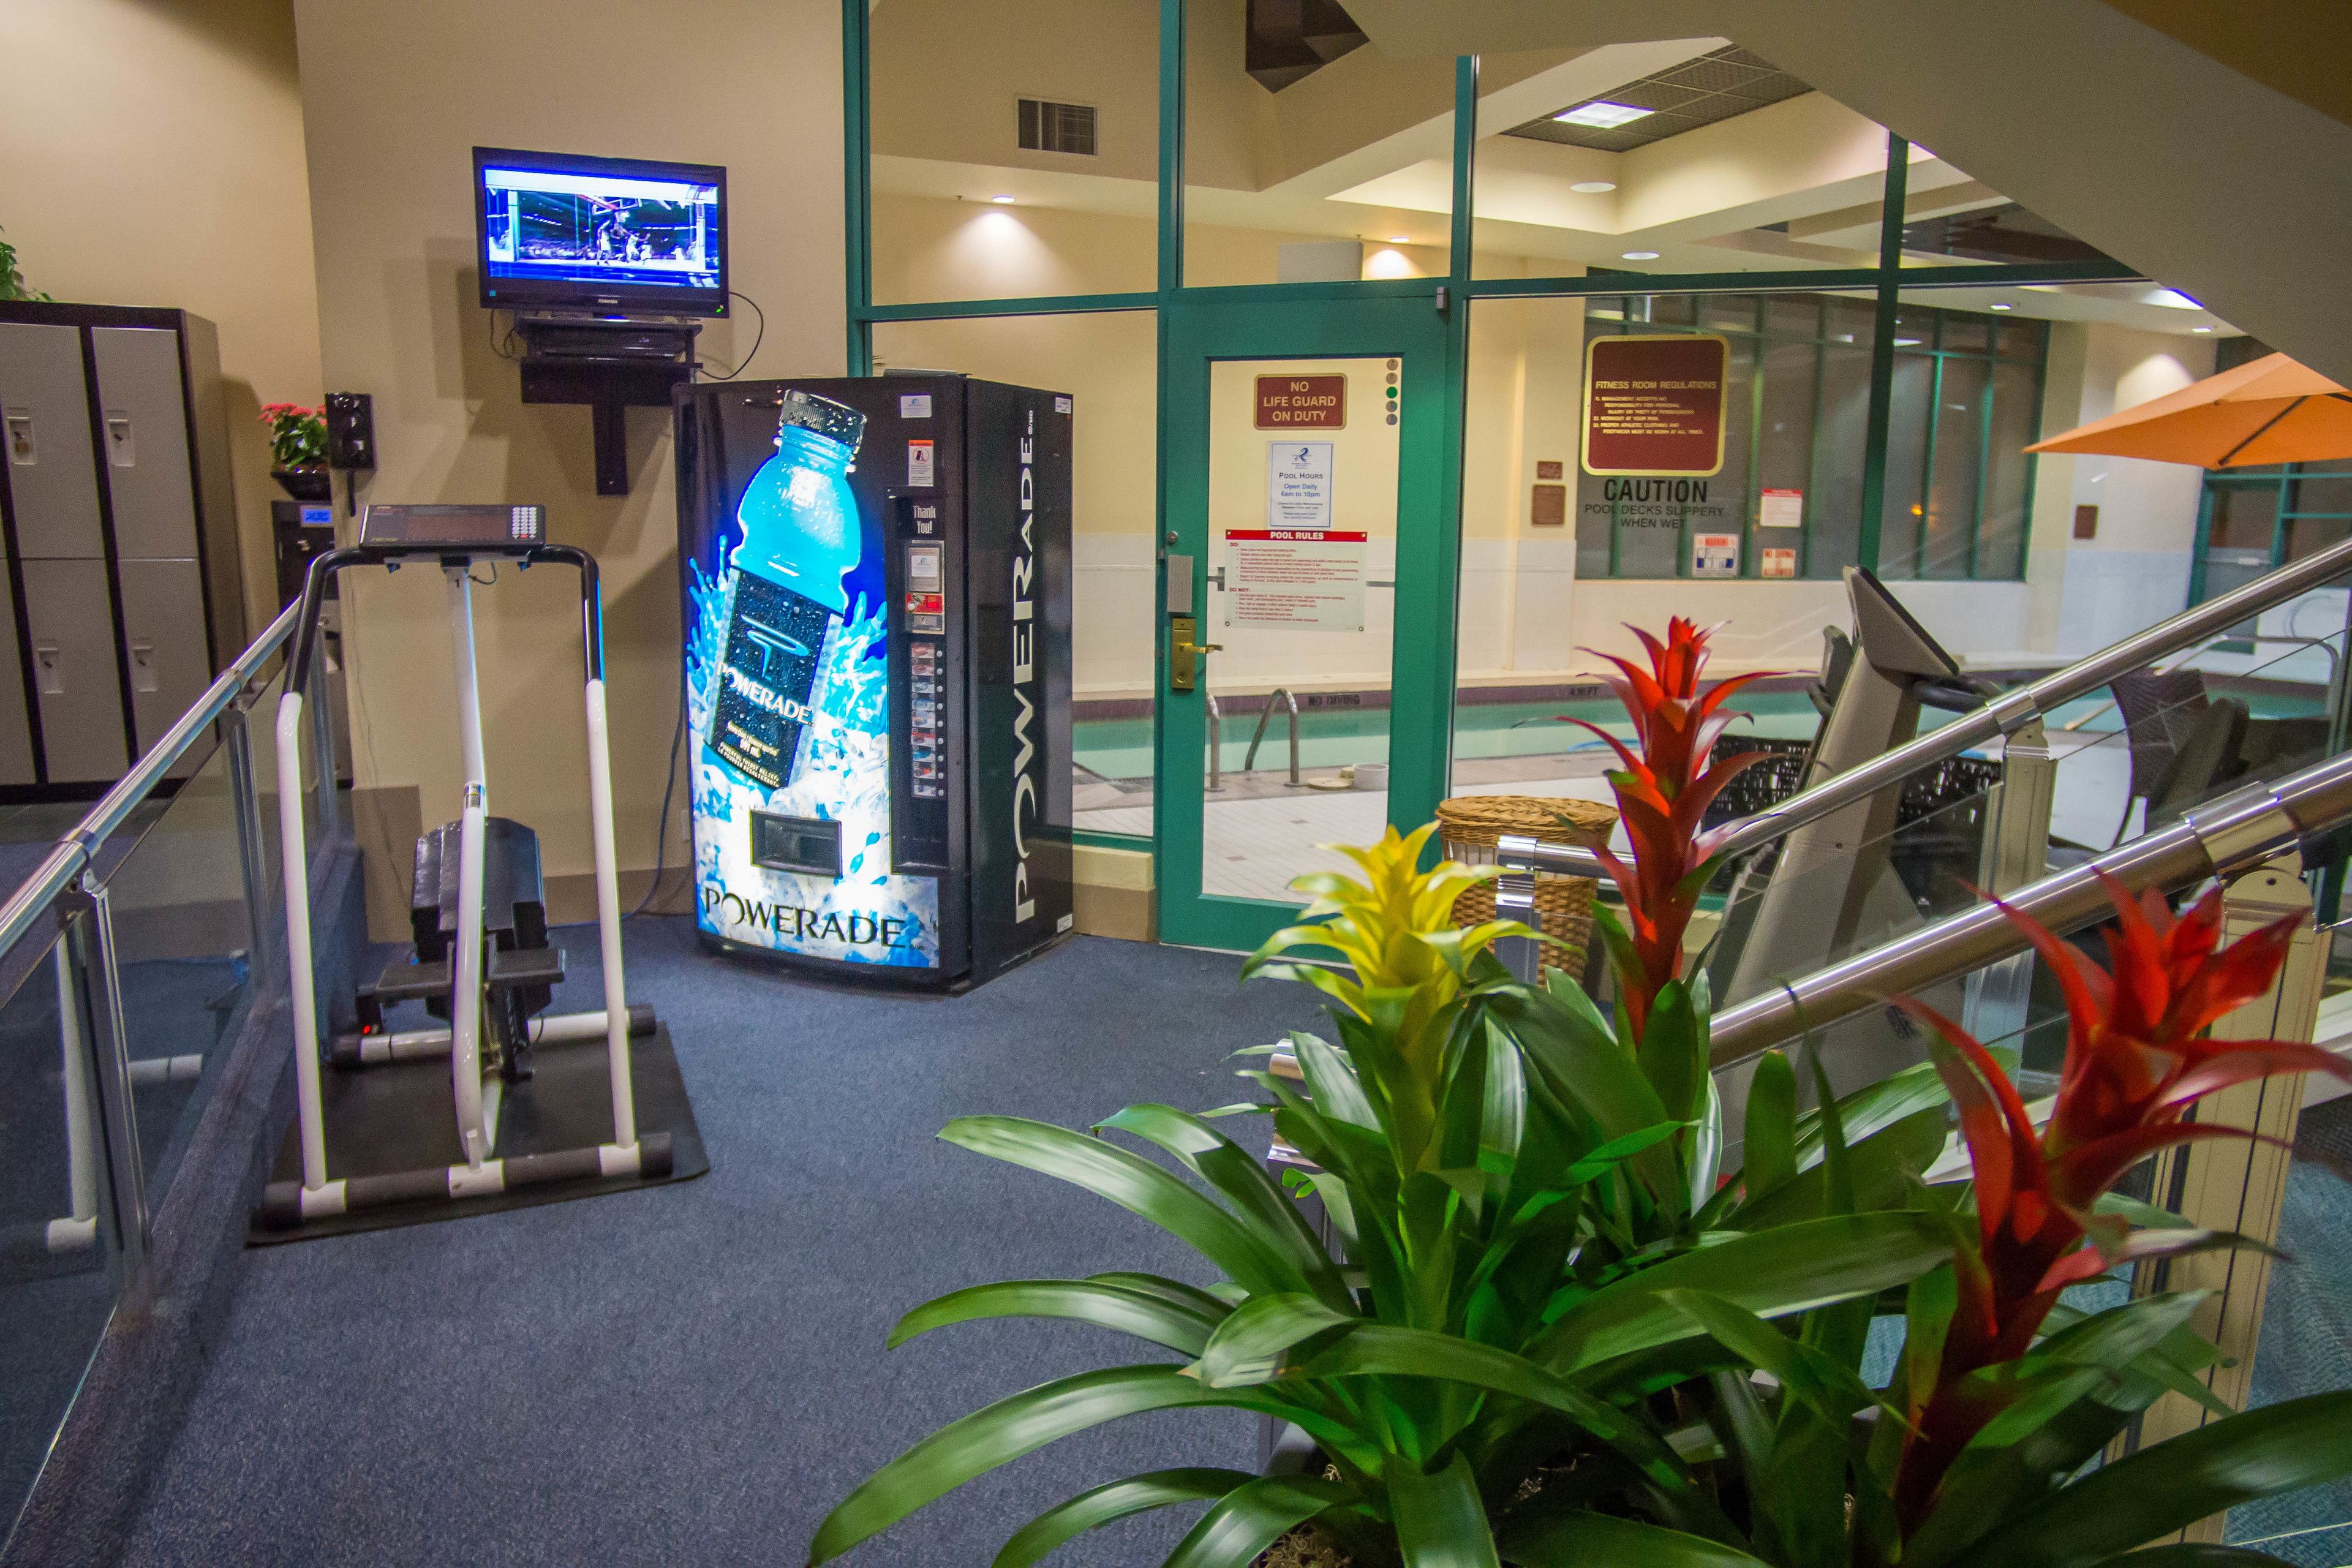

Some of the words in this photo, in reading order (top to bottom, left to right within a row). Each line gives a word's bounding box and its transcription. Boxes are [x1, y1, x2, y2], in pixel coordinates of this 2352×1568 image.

[1291, 382, 1309, 391] NO
[1264, 397, 1288, 407] LIFE
[1292, 396, 1336, 406] GUARD
[1272, 411, 1290, 421] ON
[1294, 411, 1326, 421] DUTY
[1604, 479, 1708, 502] CAUTION
[913, 505, 936, 519] Thank
[1585, 505, 1618, 515] POOL
[1622, 505, 1662, 516] DECKS
[1665, 505, 1725, 517] SLIPPERY
[916, 521, 933, 534] You!
[1621, 518, 1658, 528] WHEN
[1014, 437, 1036, 924] POWERADE
[717, 662, 810, 725] POWERADE
[704, 888, 905, 948] POWERADE
